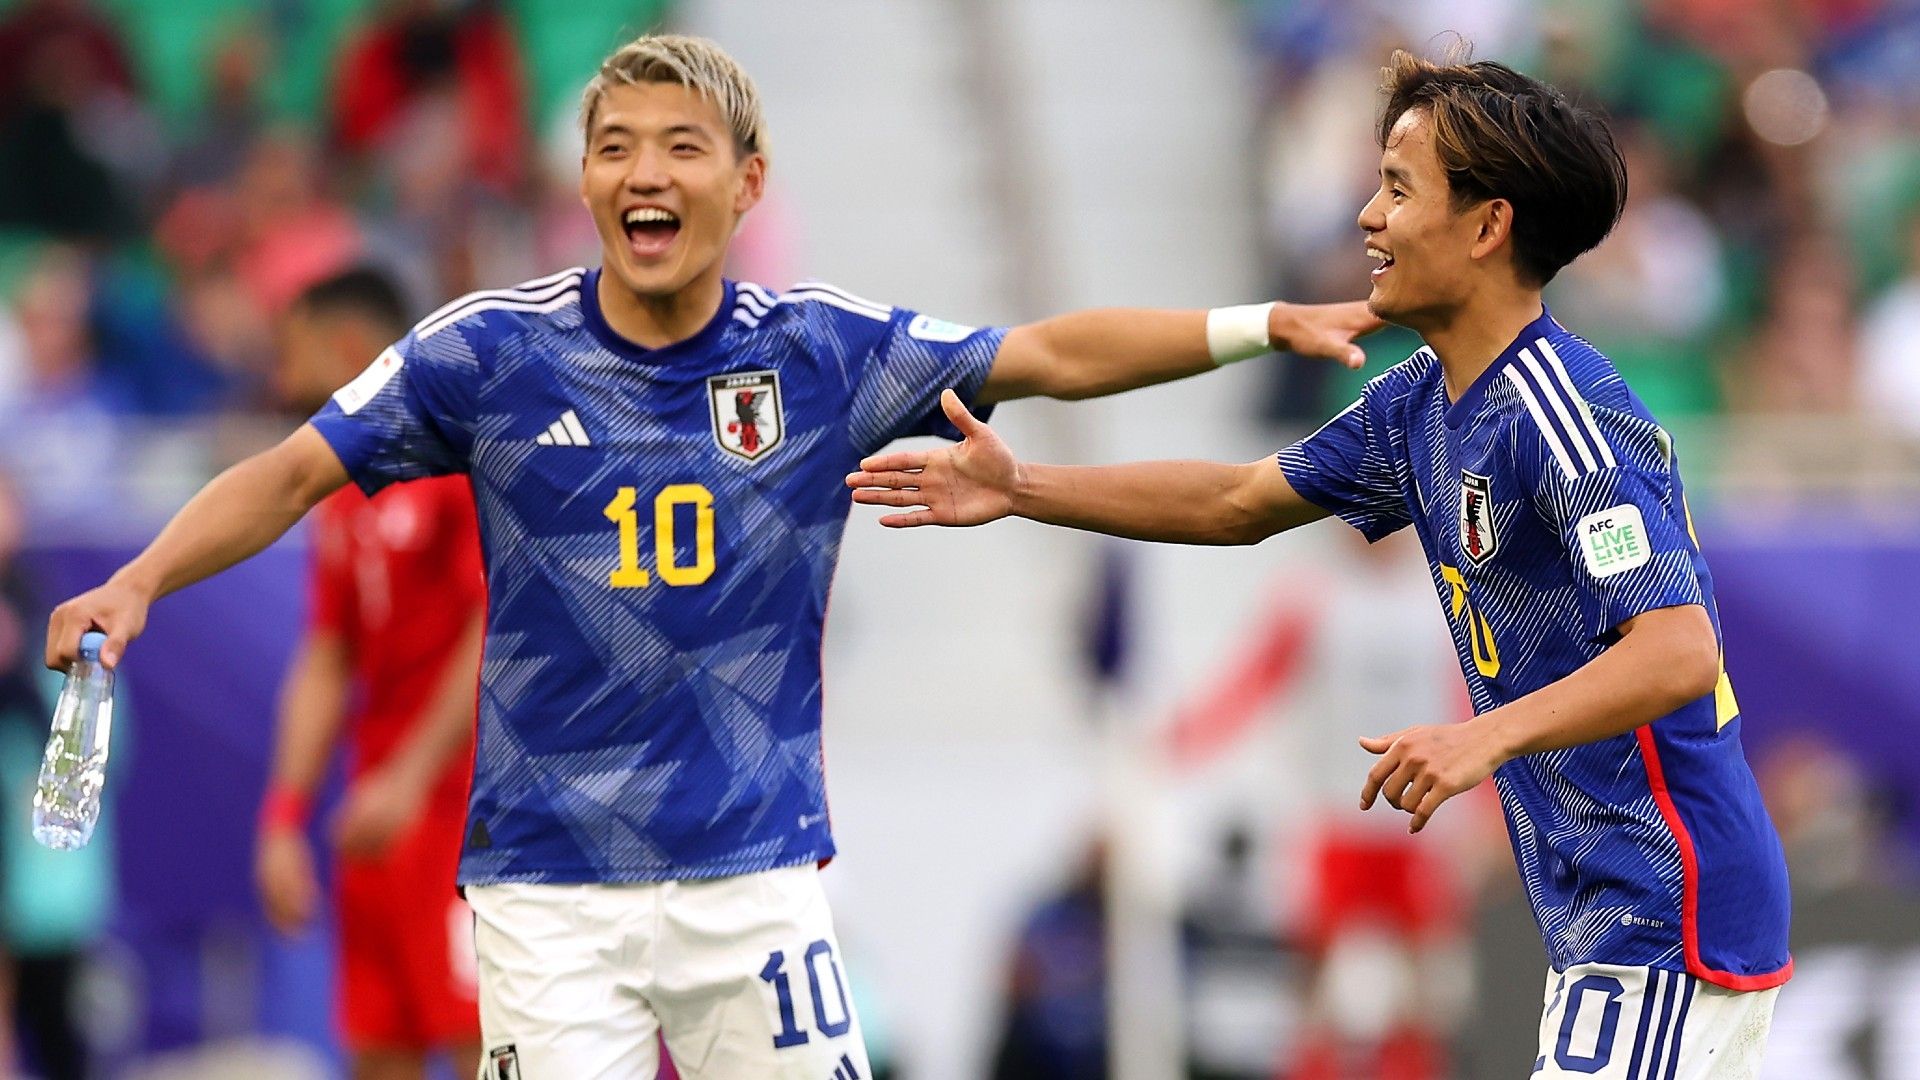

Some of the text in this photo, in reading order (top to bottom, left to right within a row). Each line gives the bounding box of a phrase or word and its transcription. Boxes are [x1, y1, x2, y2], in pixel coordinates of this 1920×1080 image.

[725, 377, 761, 389] JAPAN
[603, 483, 716, 589] 10
[1589, 518, 1614, 534] AFC
[1591, 524, 1635, 551] LIVE
[759, 938, 850, 1048] 10
